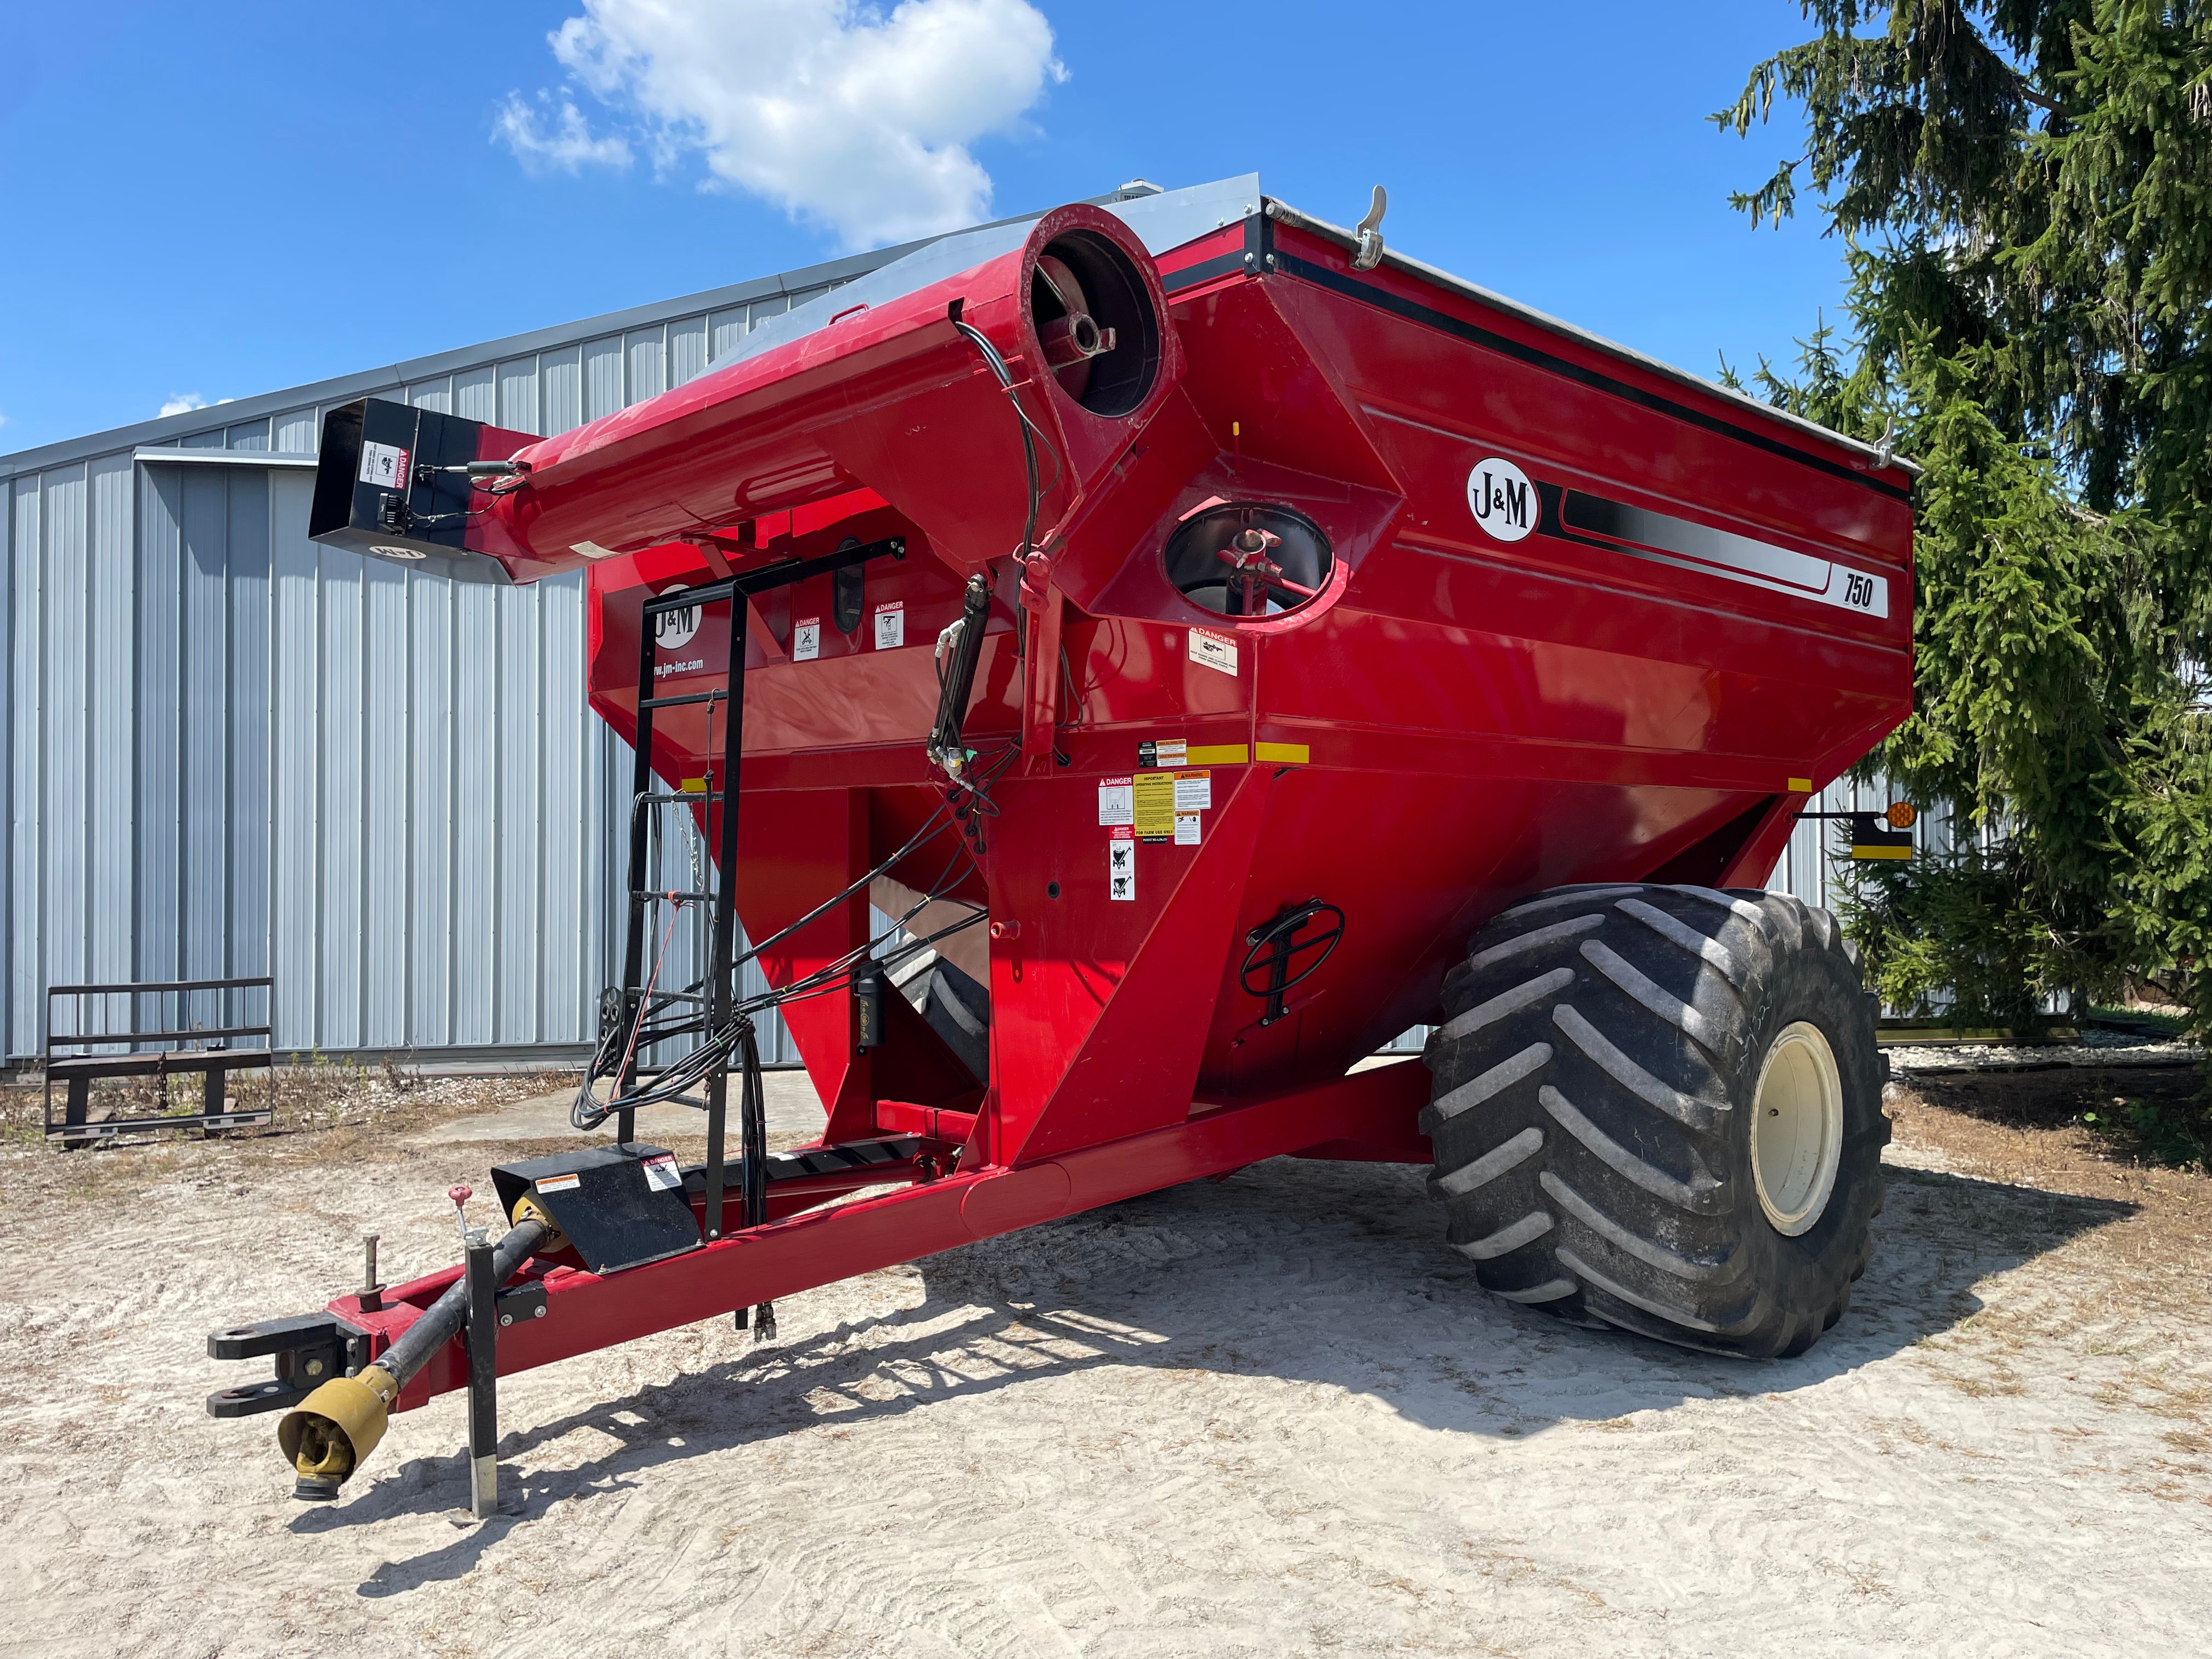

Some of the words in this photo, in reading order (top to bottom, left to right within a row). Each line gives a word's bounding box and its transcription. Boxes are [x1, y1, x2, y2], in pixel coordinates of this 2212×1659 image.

[396, 457, 407, 489] DANGER
[1473, 471, 1527, 529] J&M
[1844, 573, 1873, 607] 750
[881, 601, 904, 612] DANGER
[799, 617, 820, 627] DANGER
[1199, 628, 1236, 647] DANGER
[654, 659, 703, 678] w.jm-inc.com
[1106, 777, 1132, 786] DANGER
[650, 1156, 673, 1164] DANGER
